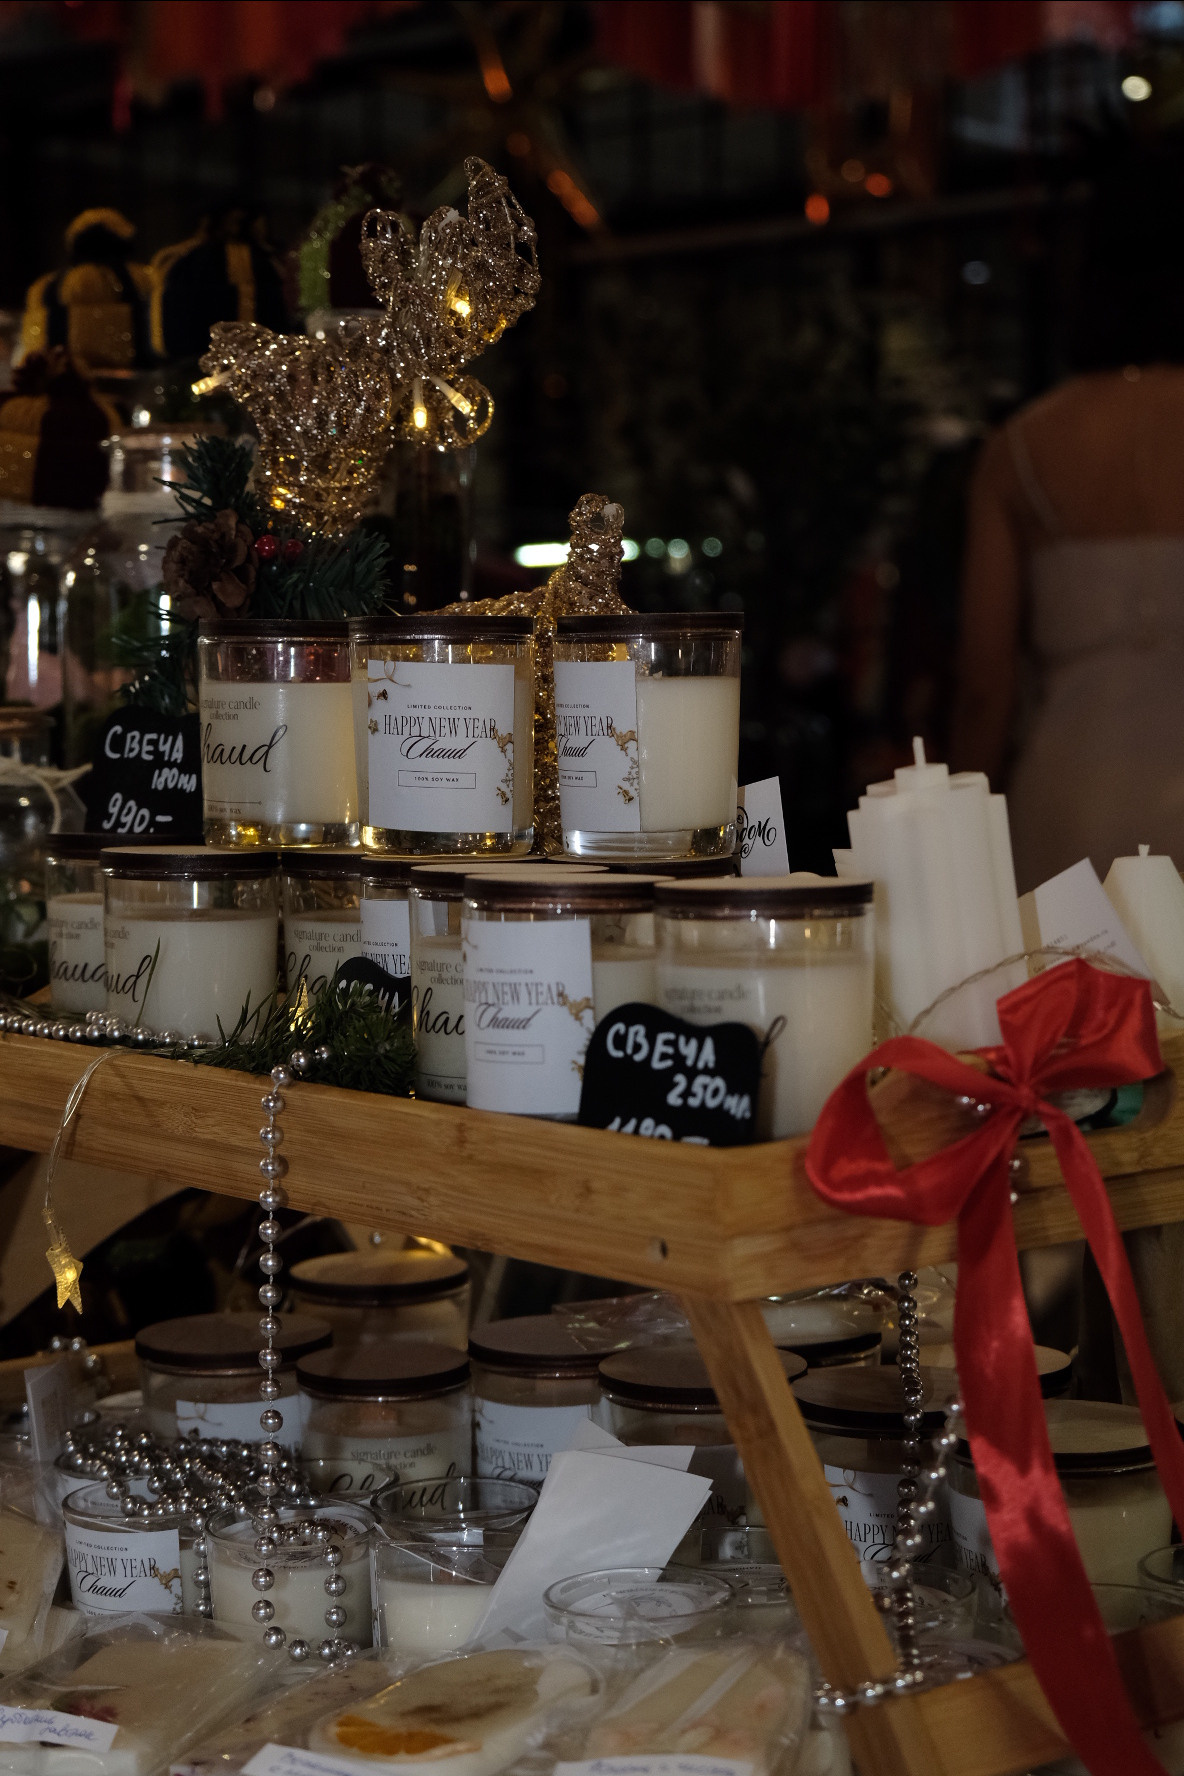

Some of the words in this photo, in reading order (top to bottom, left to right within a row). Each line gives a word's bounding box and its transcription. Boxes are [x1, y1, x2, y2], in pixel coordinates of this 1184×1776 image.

[227, 696, 261, 710] candle
[383, 714, 425, 737] HAPPY
[428, 716, 461, 739] NEW
[463, 717, 497, 739] YEAR
[583, 715, 614, 737] YEAR
[104, 725, 184, 763] СВЕЧА
[202, 722, 288, 773] haud
[399, 735, 478, 760] Chaud
[308, 942, 345, 953] collection
[332, 929, 362, 943] candl
[491, 980, 521, 1006] NEW
[524, 981, 566, 1007] YEAR
[474, 1002, 542, 1031] Chaud
[605, 1021, 717, 1071] СВЕЧА
[456, 1083, 468, 1091] wa
[508, 1450, 535, 1471] NEW
[927, 1522, 953, 1543] YEA
[93, 1544, 128, 1552] COLLECTION
[91, 1554, 118, 1578] NEW
[120, 1557, 157, 1578] YEAR
[75, 1570, 137, 1599] Chaud
